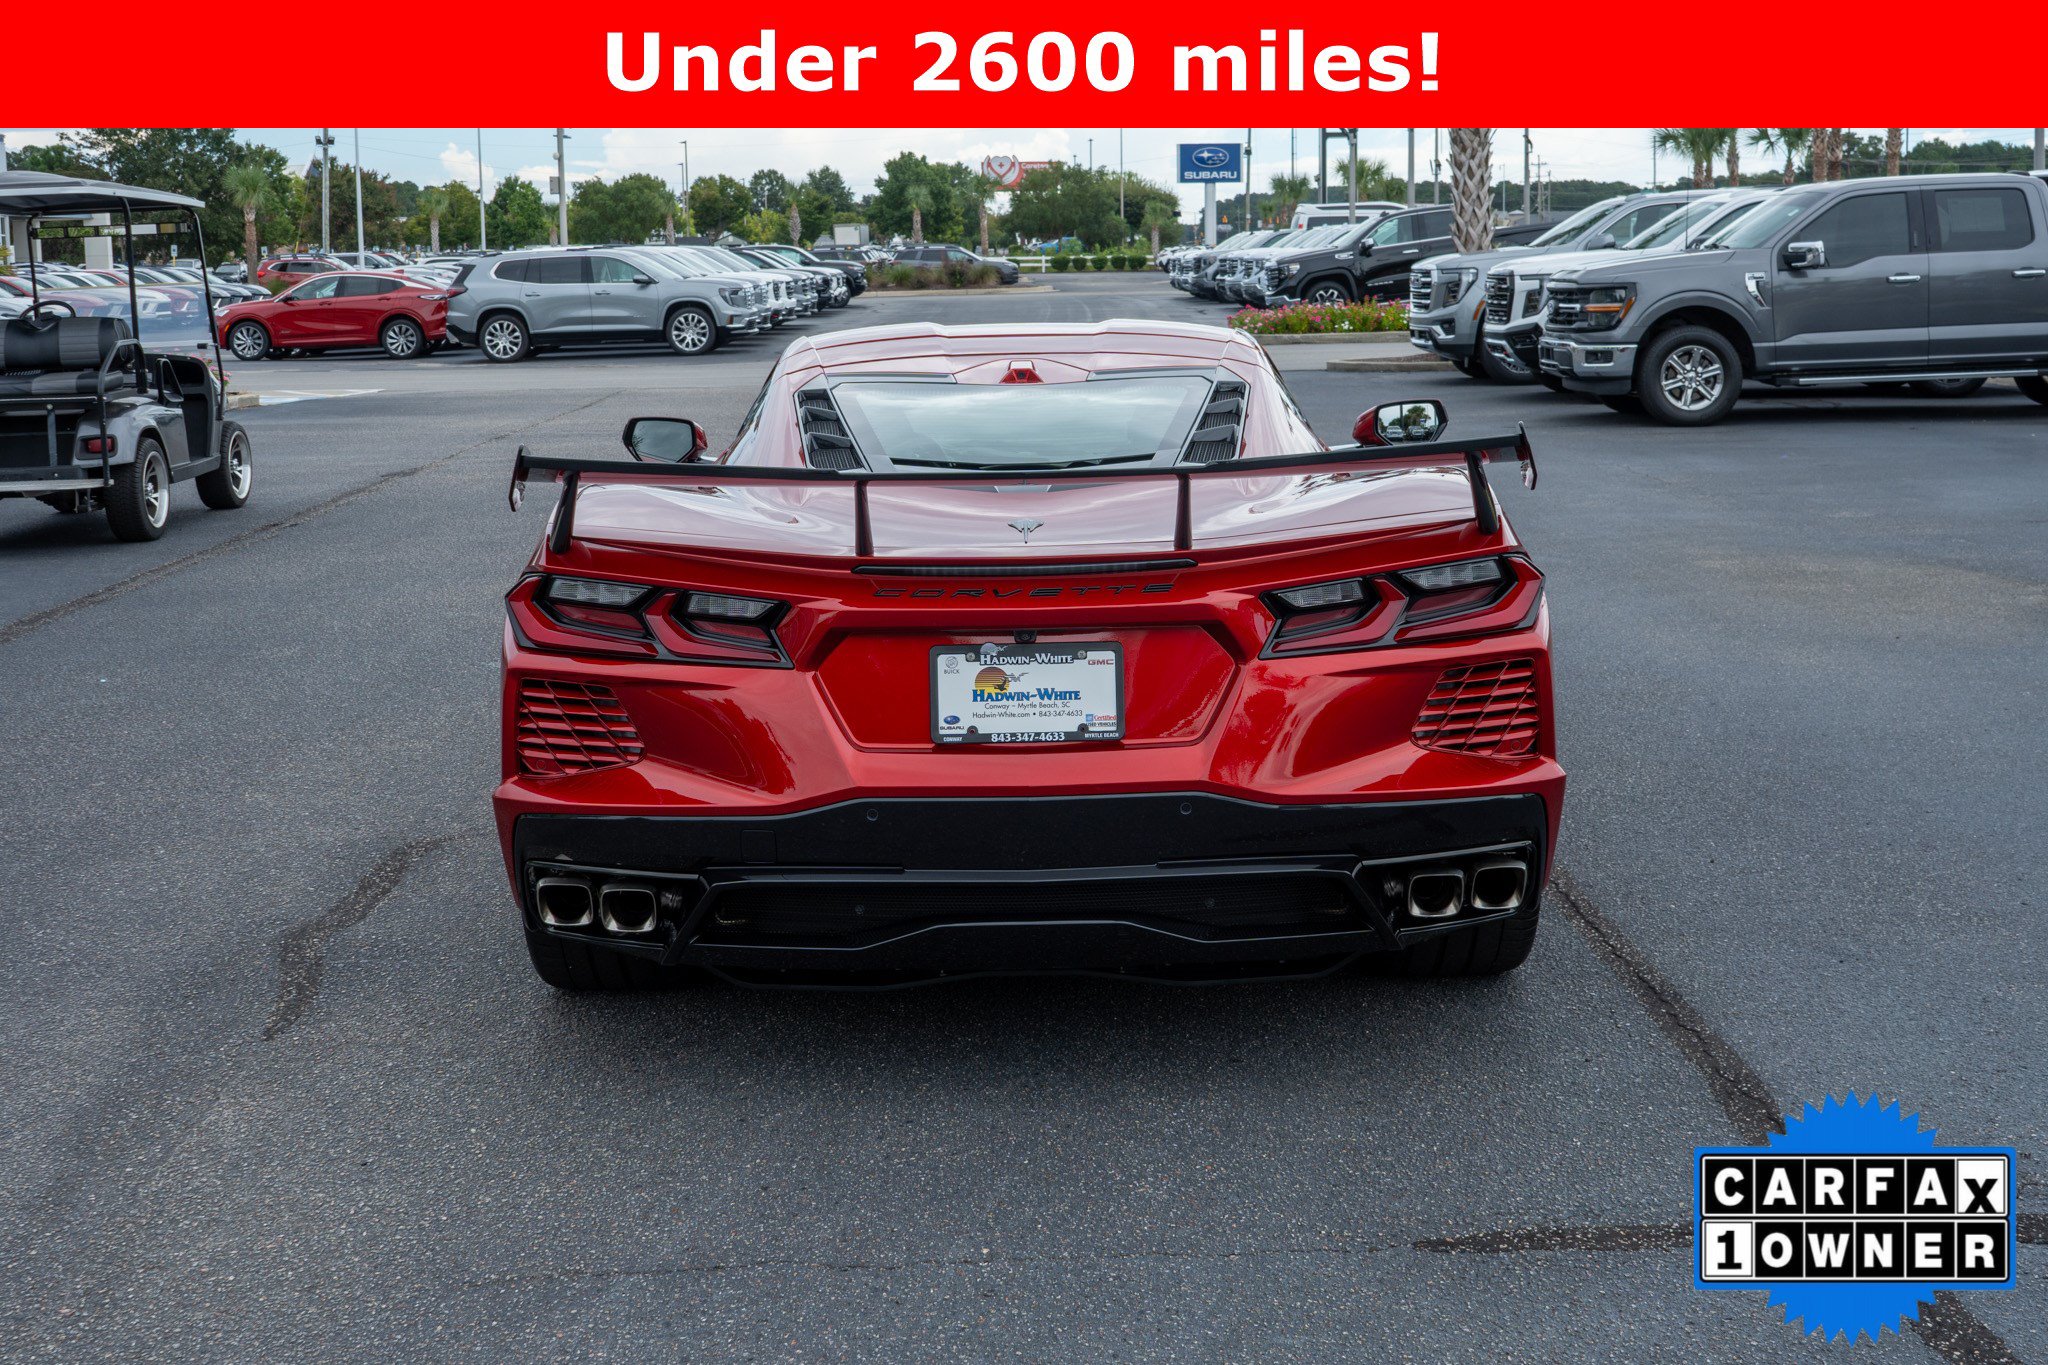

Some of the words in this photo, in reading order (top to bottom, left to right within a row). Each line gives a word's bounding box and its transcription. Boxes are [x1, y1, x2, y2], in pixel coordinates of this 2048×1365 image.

[1184, 171, 1237, 179] SUBARU
[873, 583, 1175, 598] CORVETTE
[972, 711, 1031, 719] Hadwin-White.com
[991, 732, 1065, 742] 843-347-4633
